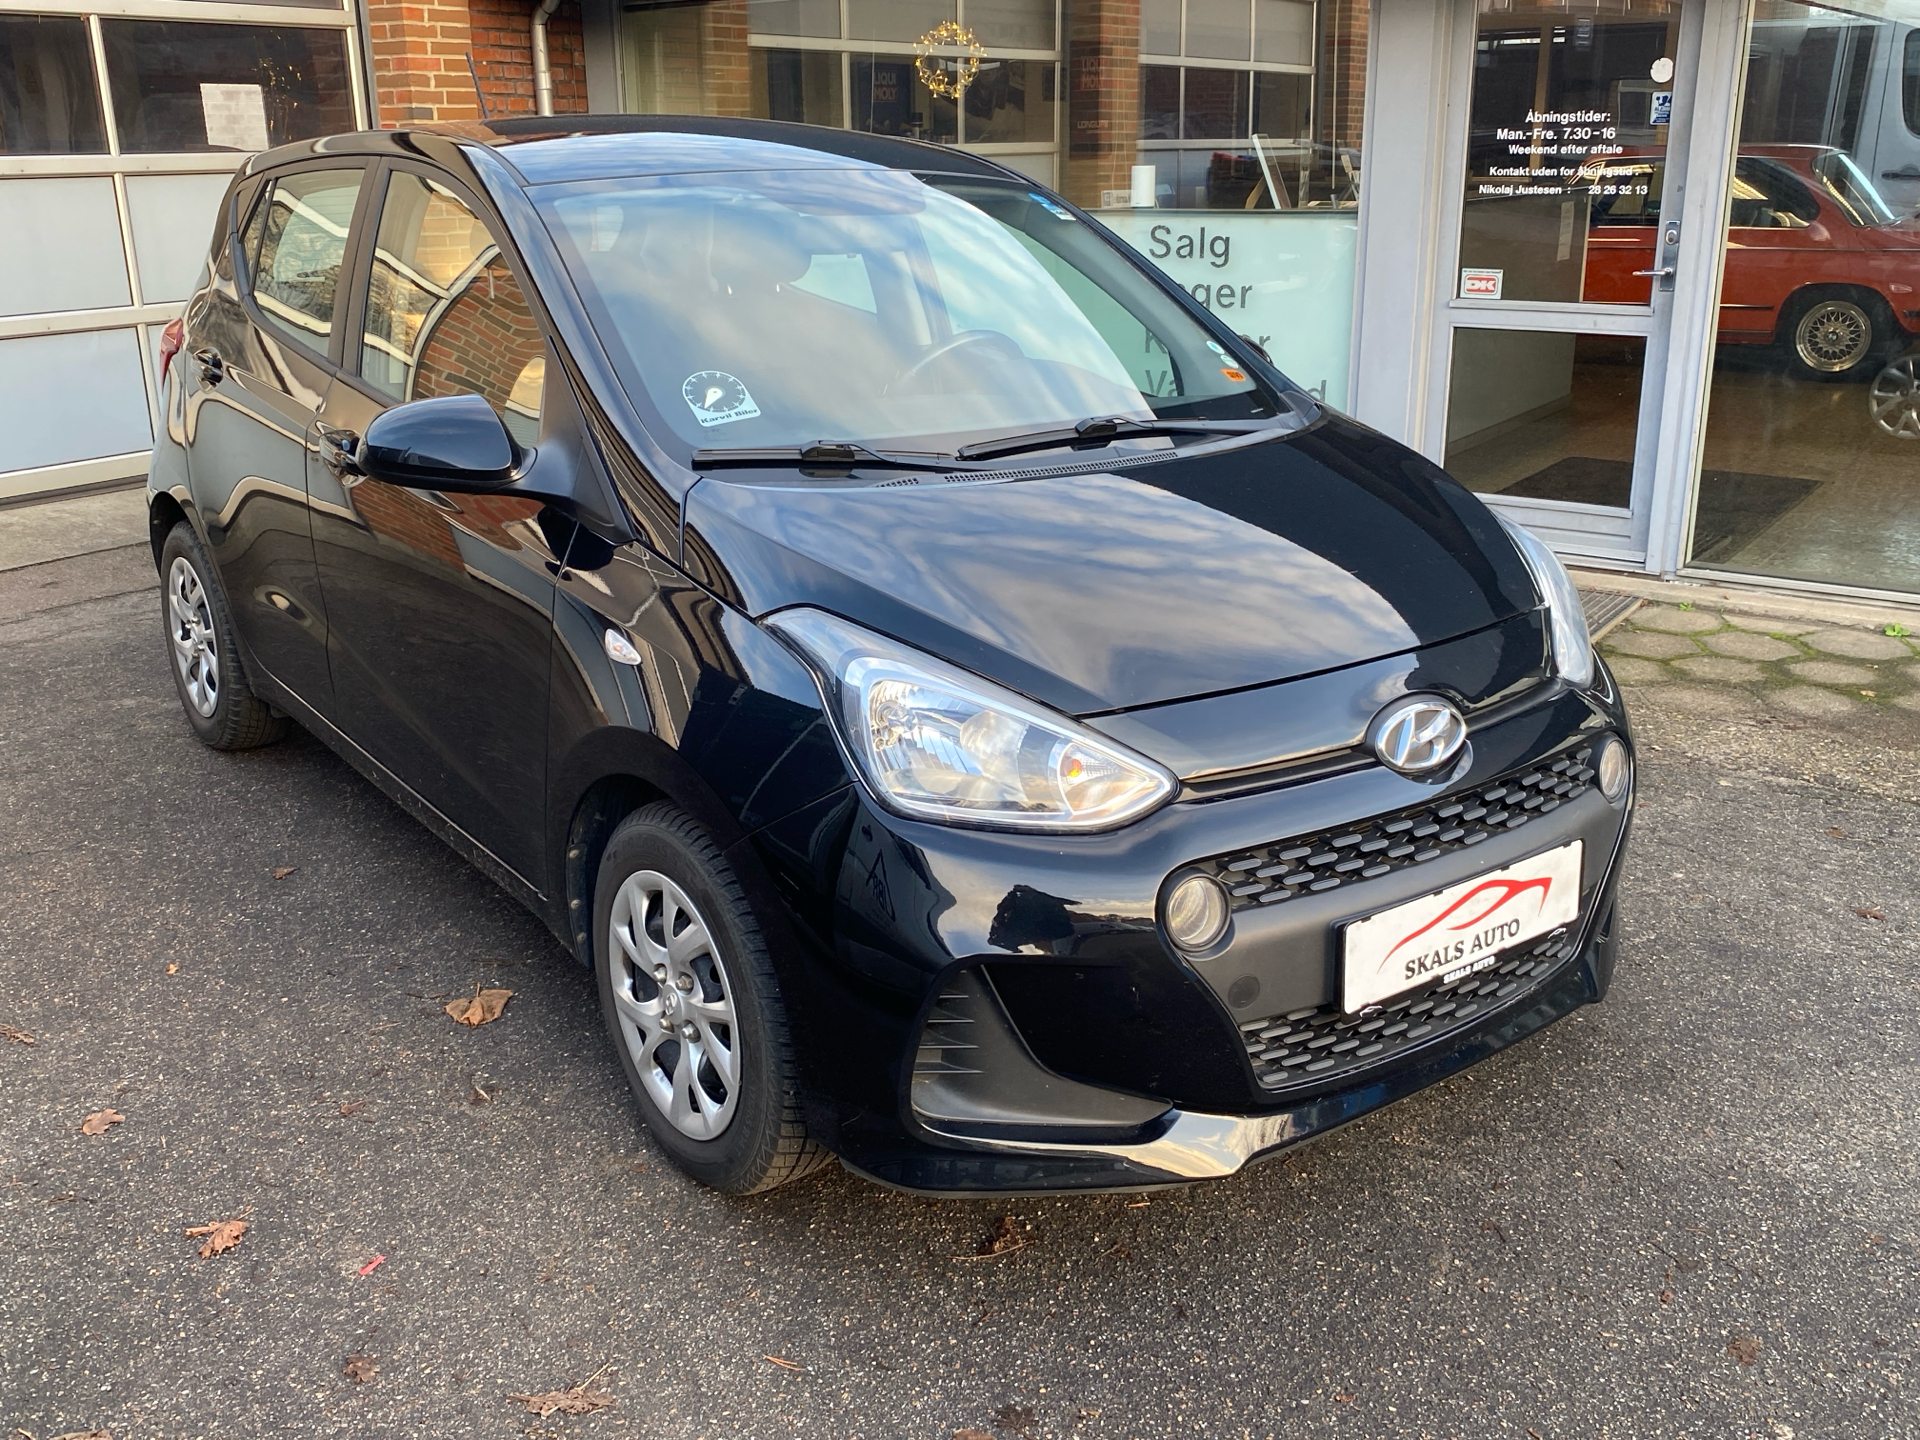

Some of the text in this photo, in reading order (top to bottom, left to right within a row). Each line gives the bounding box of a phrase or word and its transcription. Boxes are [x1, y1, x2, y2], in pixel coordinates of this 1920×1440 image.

[874, 71, 897, 85] LIQUI
[873, 87, 897, 100] MOLY
[1525, 109, 1611, 125] Åbningstider:
[1508, 144, 1623, 155] Weekend efter aftale
[1489, 166, 1529, 177] Kontakt
[1531, 166, 1561, 177] uden
[1562, 166, 1575, 177] for
[1479, 185, 1513, 196] Nikolaj
[1515, 185, 1562, 195] Justesen
[1588, 185, 1601, 195] 28
[1603, 185, 1617, 195] 26
[1618, 185, 1632, 195] 32
[1635, 185, 1648, 195] 13
[1149, 225, 1230, 268] Salg
[1466, 279, 1497, 291] DK
[734, 408, 758, 418] Biler
[1404, 918, 1520, 980] SKALS AUTO
[1443, 955, 1496, 984] SKALS AUTO
